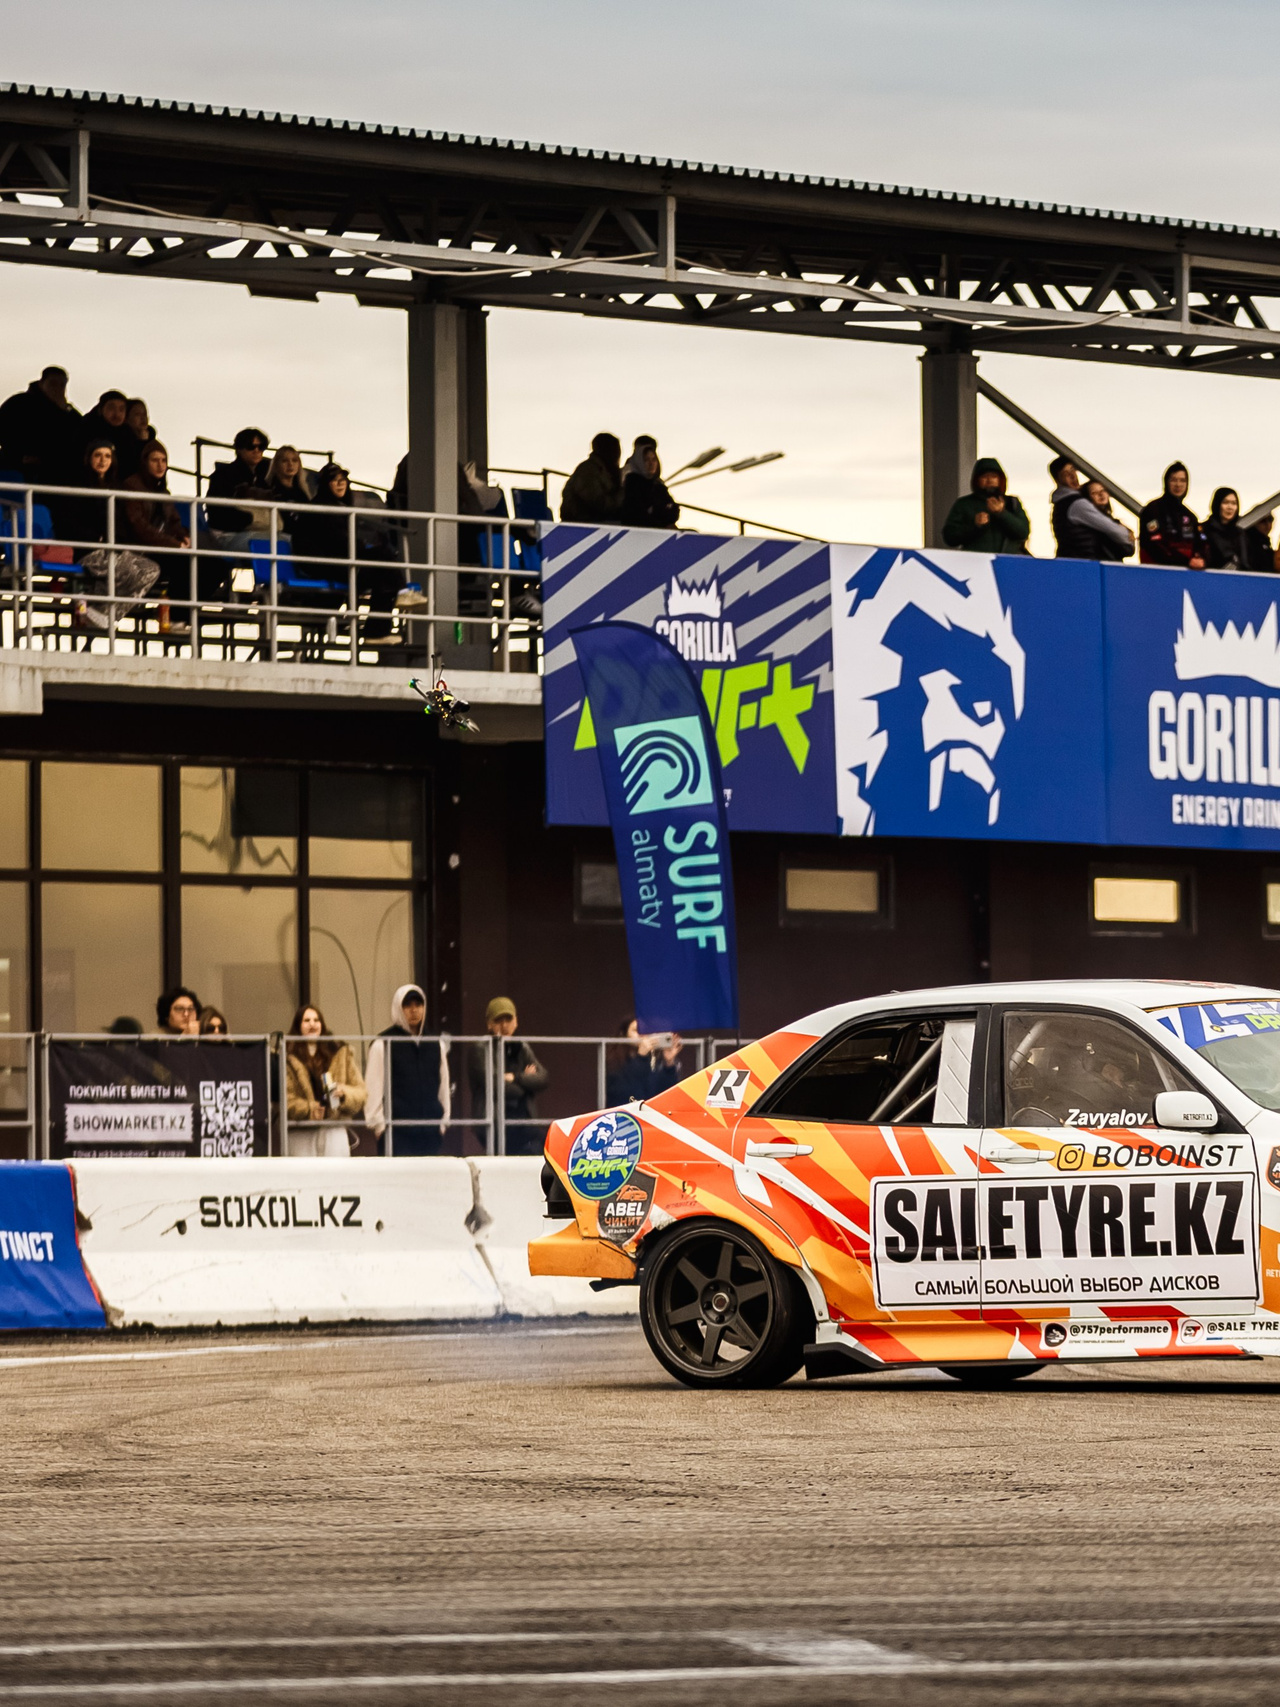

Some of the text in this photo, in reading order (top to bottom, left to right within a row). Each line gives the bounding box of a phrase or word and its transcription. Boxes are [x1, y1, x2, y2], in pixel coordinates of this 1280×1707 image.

[1171, 794, 1240, 827] ENERGY
[631, 828, 663, 929] almaty
[663, 820, 728, 954] SURF
[69, 1082, 188, 1099] ПОКУПАЙТЕ БИЛЕТЫ НА
[73, 1114, 187, 1131] SHOWMARKET.KZ
[1065, 1108, 1148, 1129] Zavyalov
[1092, 1144, 1244, 1168] BOBOINST
[200, 1195, 362, 1227] SOKOL.KZ
[604, 1202, 645, 1217] ABEL
[604, 1216, 643, 1228] ЧИНИТ
[884, 1181, 1244, 1263] SALETYRE.KZ
[914, 1274, 1221, 1296] САМЫЙ БОЛЬШОЙ ВЫБОР ДИСКОВ
[1069, 1324, 1170, 1337] @757performance
